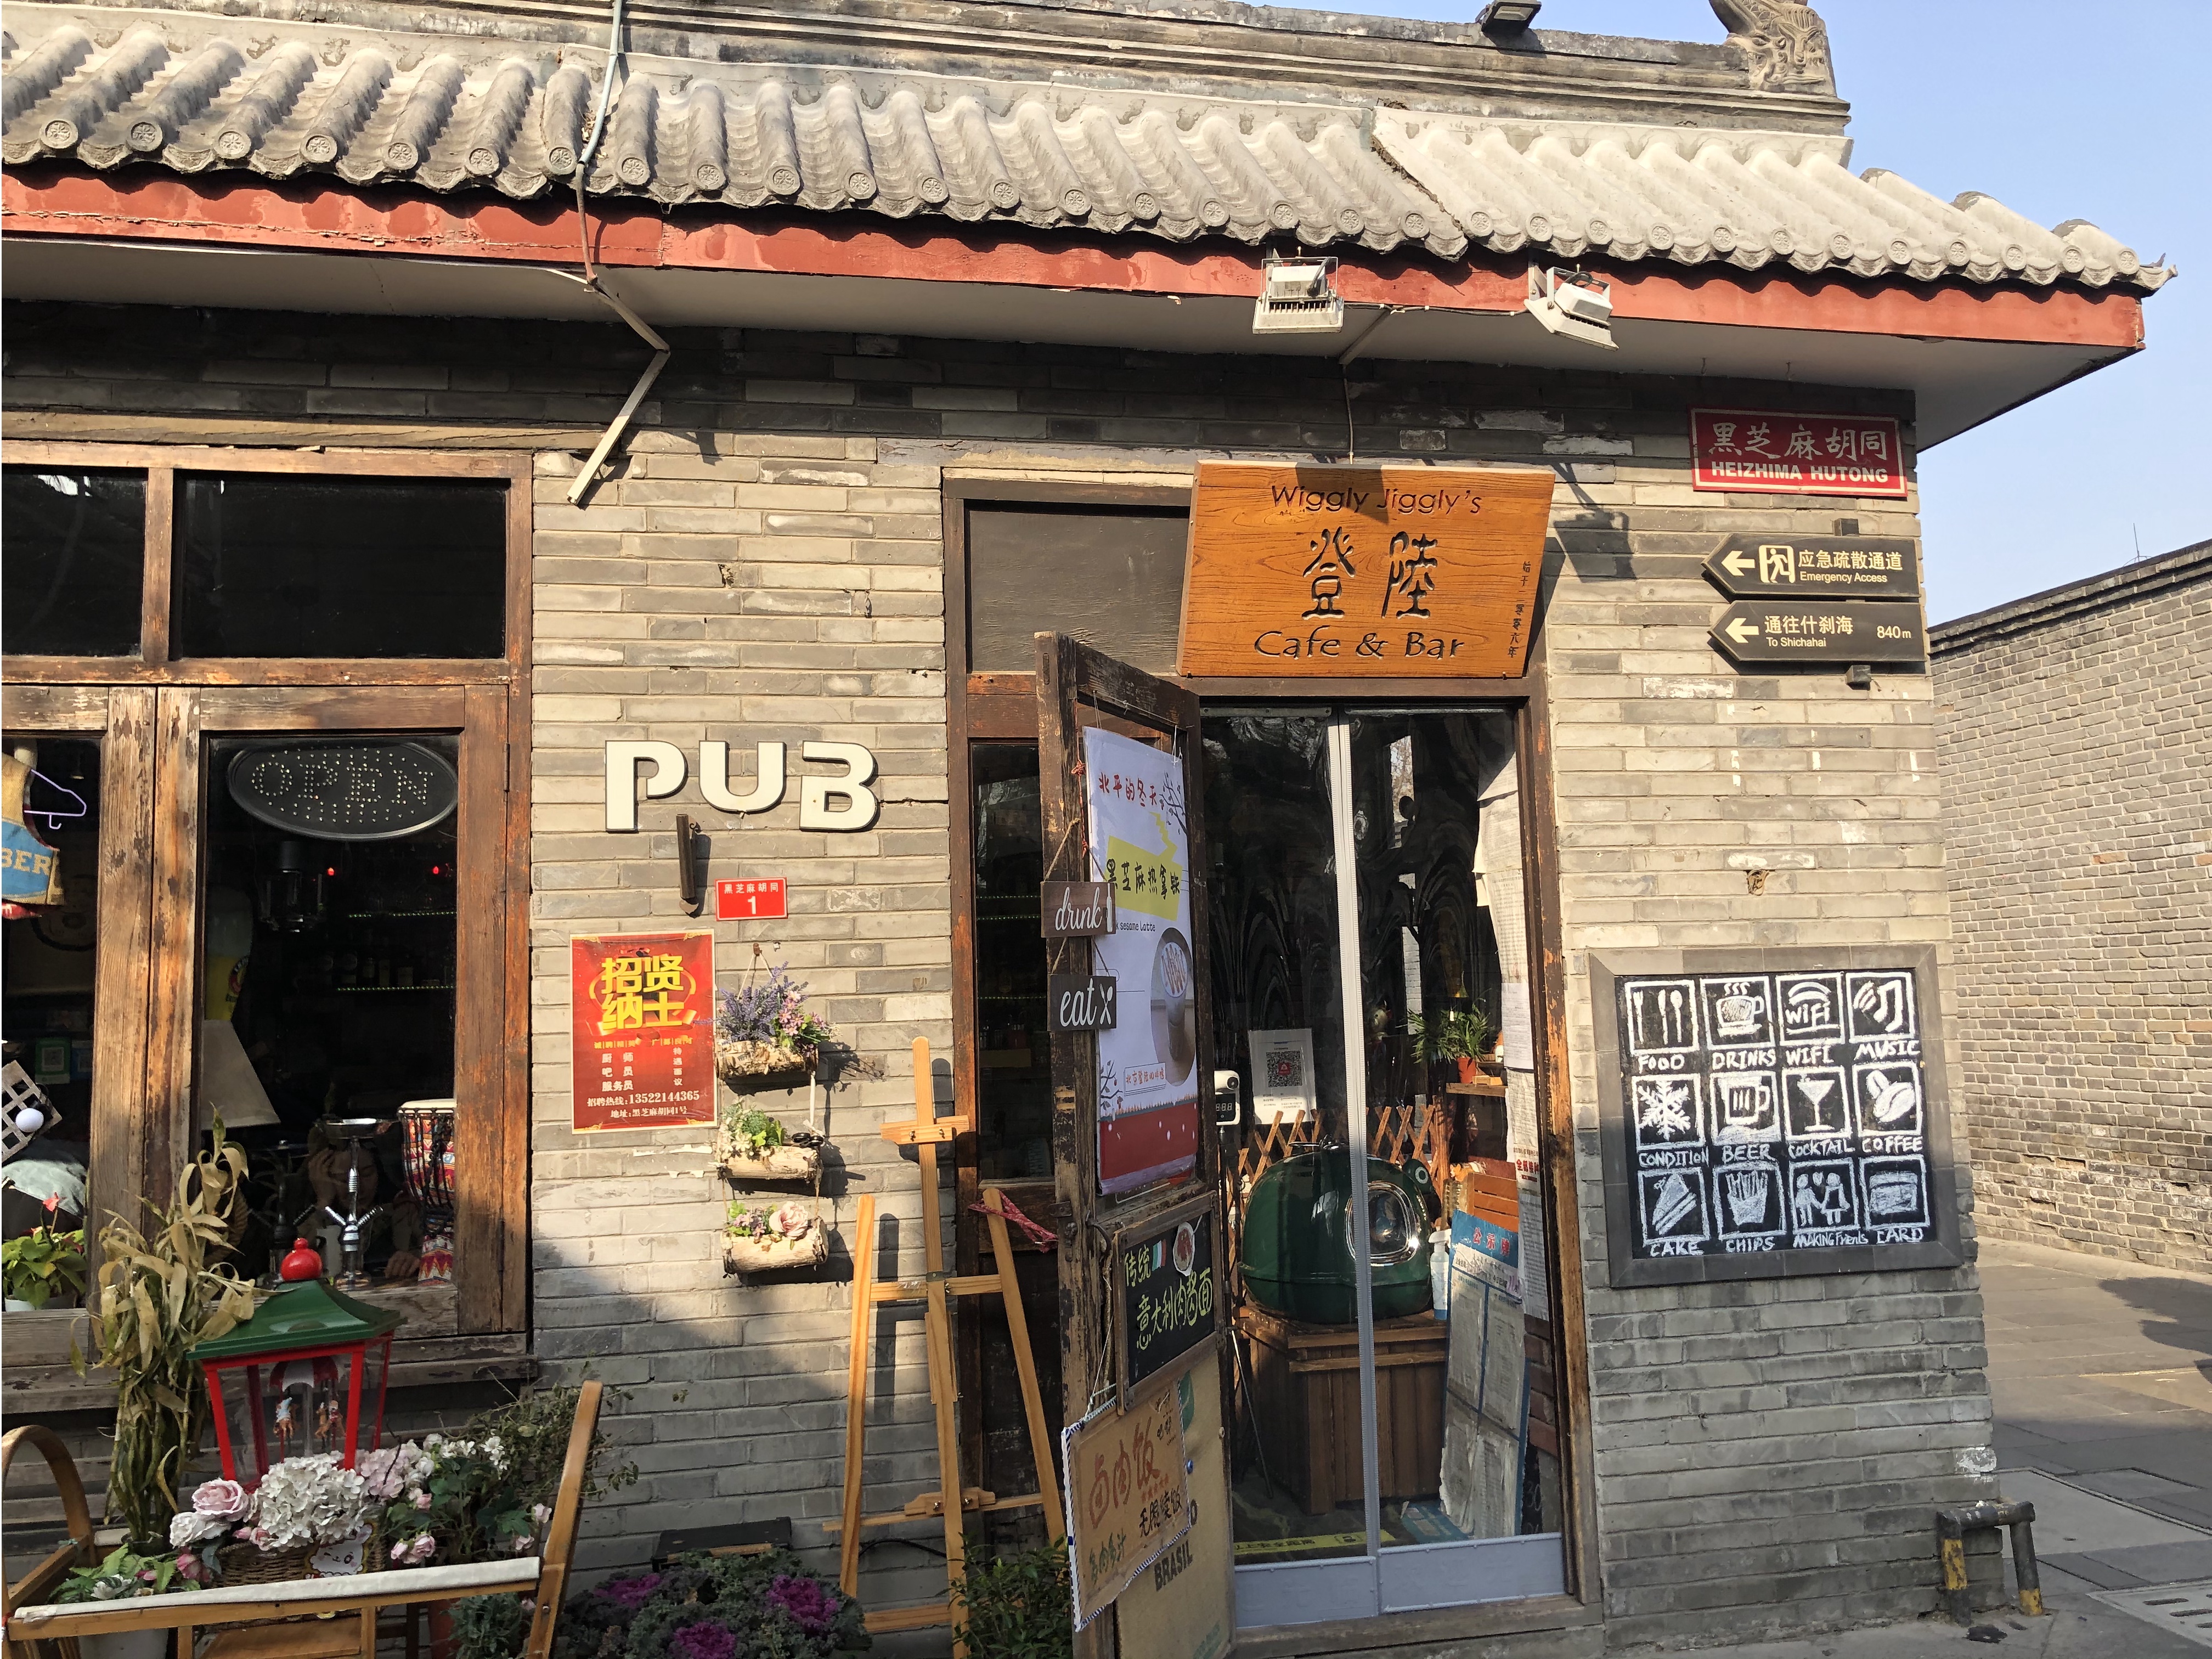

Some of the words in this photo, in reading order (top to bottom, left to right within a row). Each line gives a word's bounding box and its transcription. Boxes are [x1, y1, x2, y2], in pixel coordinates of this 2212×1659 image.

[1709, 421, 1887, 460] 黑芝麻胡同
[1711, 461, 1803, 481] HEIZHIMA
[1810, 464, 1888, 483] HUTONG
[1271, 484, 1369, 513] Wiggly
[1376, 487, 1483, 515] Jiggly's
[1797, 550, 1903, 571] 应急疏散通道
[1799, 572, 1853, 584] Emergency
[1854, 572, 1888, 583] Access
[1764, 615, 1854, 635] 通往什刹海
[1254, 625, 1341, 660] Cafe
[1356, 633, 1388, 659] &
[1404, 631, 1465, 660] Bar
[1766, 637, 1778, 647] To
[1780, 637, 1826, 648] Shichahai
[251, 762, 434, 805] OPEN
[605, 740, 880, 832] PUB
[1098, 771, 1157, 808] 北平的冬天
[724, 882, 778, 894] 黑芝麻胡同
[747, 895, 757, 915] 1
[1055, 887, 1102, 931] drink
[1120, 922, 1139, 932] sesame
[1140, 921, 1156, 932] latte
[601, 955, 684, 994] 招贤
[601, 991, 685, 1030] 纳士
[1060, 978, 1097, 1027] eat
[1712, 1049, 1777, 1069] DRINKS
[1785, 1045, 1835, 1066] WIFI
[1854, 1040, 1921, 1061] MUSIC
[1638, 1054, 1685, 1071] FOOD
[601, 1080, 634, 1092] 服务员
[1722, 1144, 1778, 1164] BEER
[1788, 1138, 1856, 1159] COCKTAIL
[1861, 1136, 1923, 1154] COFFEE
[1639, 1146, 1709, 1170] CONDITION
[1725, 1236, 1776, 1254] CHIPS
[1876, 1227, 1924, 1244] CARD
[1650, 1240, 1705, 1257] CAKE
[1125, 1244, 1151, 1287] 传统
[1154, 1539, 1194, 1592] BRASIL
